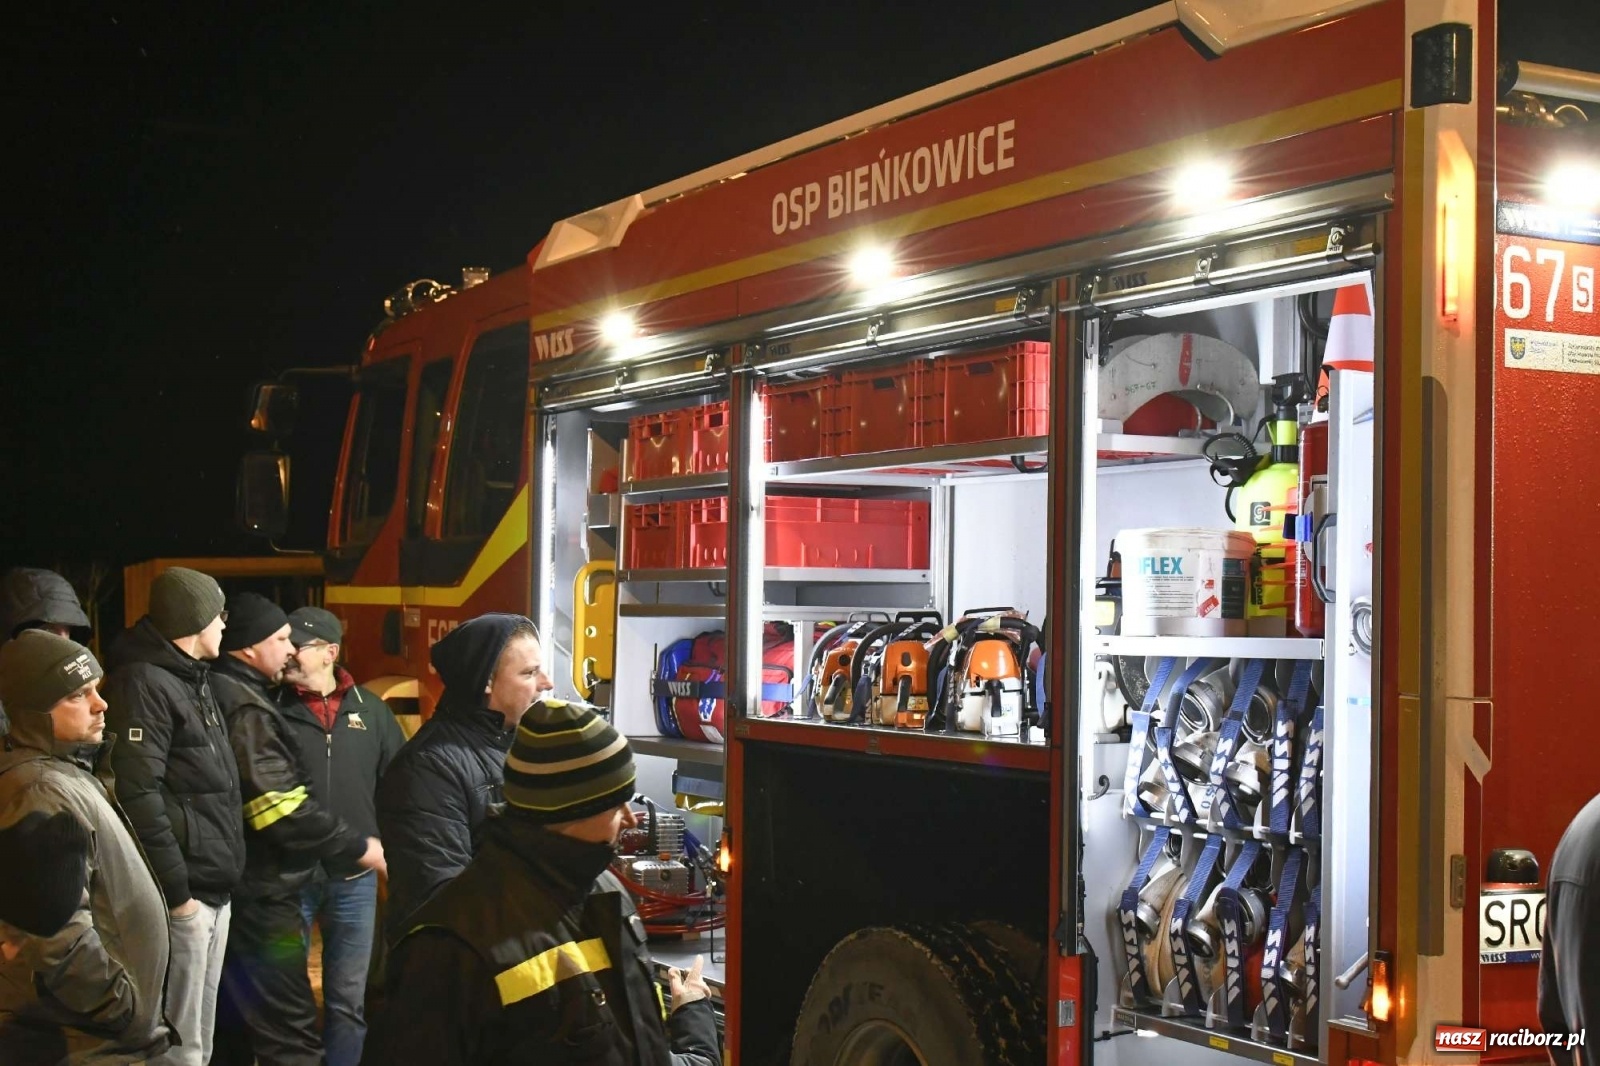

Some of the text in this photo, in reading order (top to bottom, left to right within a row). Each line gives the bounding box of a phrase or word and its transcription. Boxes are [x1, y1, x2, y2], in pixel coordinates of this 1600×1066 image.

[771, 119, 1016, 235] OSP BIEŃKOWICE
[1494, 244, 1565, 323] 67
[534, 328, 575, 361] WISS
[667, 681, 691, 697] WISS
[1272, 720, 1295, 809] WISS
